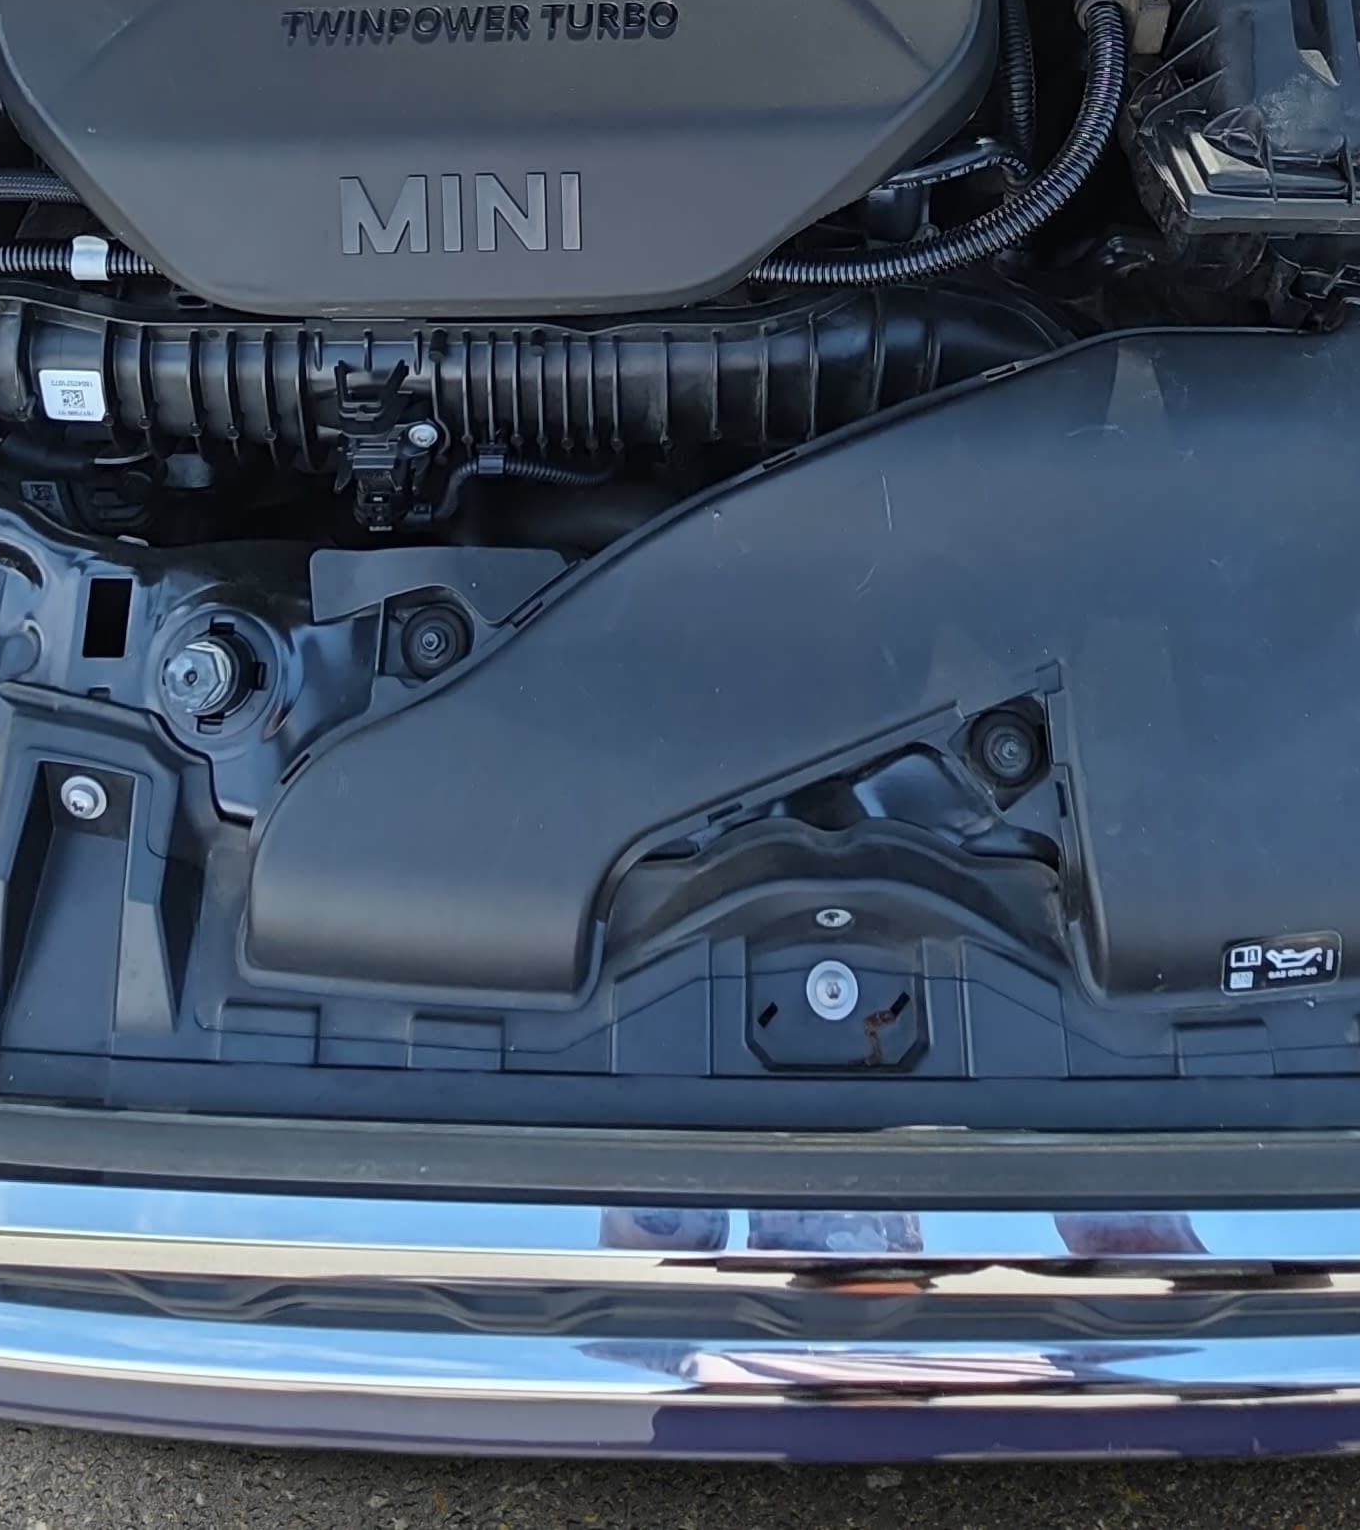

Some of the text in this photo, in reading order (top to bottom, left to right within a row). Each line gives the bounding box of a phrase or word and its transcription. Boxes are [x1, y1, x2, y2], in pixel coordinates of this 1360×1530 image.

[281, 0, 679, 45] TWINPOWER TURBO
[339, 172, 583, 254] MINI
